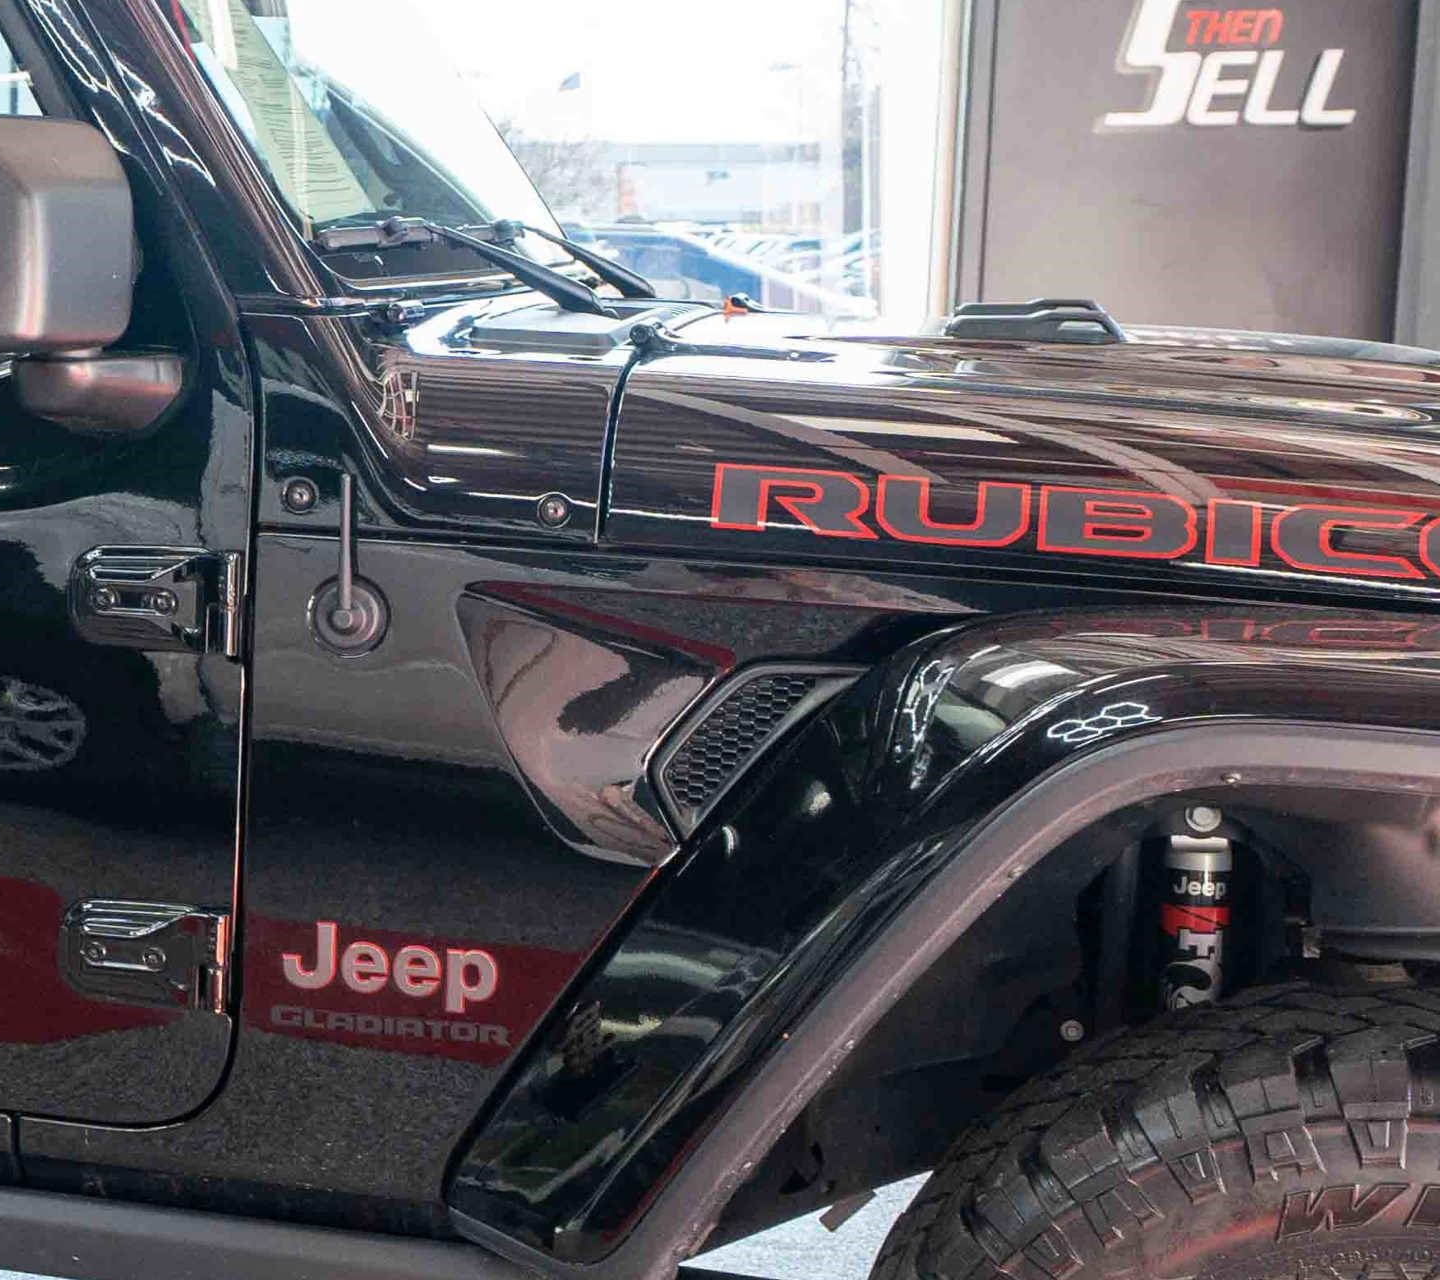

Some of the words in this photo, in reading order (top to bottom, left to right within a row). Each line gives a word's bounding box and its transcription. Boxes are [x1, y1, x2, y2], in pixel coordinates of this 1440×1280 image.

[1185, 8, 1284, 45] THEN
[1173, 875, 1227, 900] Jeep
[282, 921, 498, 1013] Jeep
[270, 1005, 511, 1047] GLADIATOR
